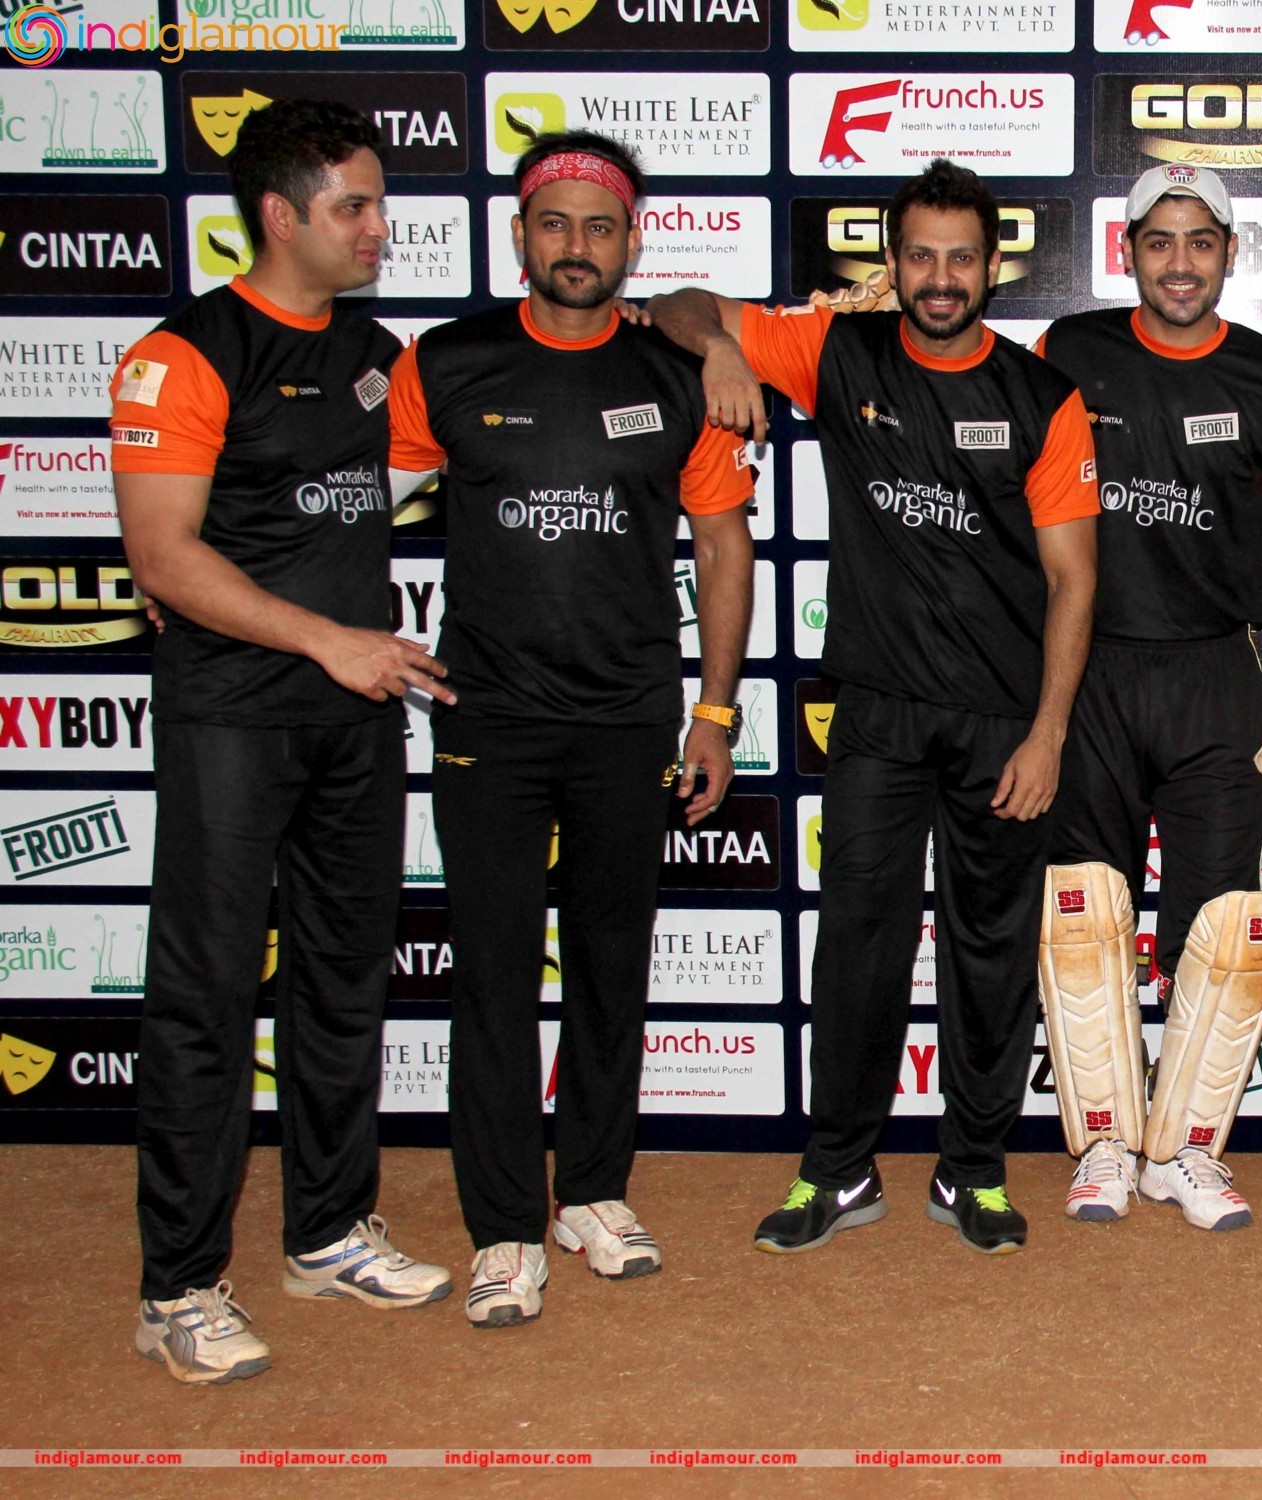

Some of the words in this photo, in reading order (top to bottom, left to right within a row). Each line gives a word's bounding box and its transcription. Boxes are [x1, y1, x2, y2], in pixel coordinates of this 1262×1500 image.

[617, 0, 760, 23] CINTAA
[885, 3, 1057, 17] ENTERTAINMENT
[887, 20, 947, 32] MEDIA
[963, 20, 999, 32] PVT.
[1018, 20, 1054, 32] LTD.
[1207, 25, 1223, 34] Visit
[1225, 26, 1234, 34] us
[1236, 26, 1252, 34] now
[1253, 25, 1261, 34] at
[901, 80, 1044, 108] frunch.us
[580, 96, 677, 122] WHITE
[690, 96, 754, 122] LEAF
[901, 122, 932, 131] Health
[935, 122, 956, 131] with
[968, 122, 1005, 131] tasteful
[1008, 122, 1040, 131] Punch!
[713, 143, 750, 155] LTD.
[901, 149, 919, 158] Visit
[920, 150, 929, 158] us
[931, 150, 946, 158] now
[948, 149, 956, 158] at
[957, 149, 1012, 158] www.frunch.us
[20, 231, 162, 269] CINTAA
[666, 244, 703, 253] tasteful
[706, 244, 738, 253] Punch!
[646, 271, 654, 279] at
[656, 271, 709, 279] www.frunch.us
[505, 416, 534, 425] CINTAA
[609, 410, 658, 431] FROOTI
[1099, 415, 1123, 425] CINTAA
[960, 429, 1005, 444] FROOTI
[1190, 421, 1234, 440] FROOTI
[14, 444, 109, 472] frunch
[15, 484, 46, 493] Health
[48, 484, 69, 493] with
[80, 484, 114, 493] tastefu
[529, 485, 599, 505] Morarka
[897, 477, 954, 504] Morarka
[1131, 477, 1188, 499] Morarka
[17, 510, 34, 519] Visit
[36, 511, 44, 519] us
[46, 511, 60, 519] now
[61, 510, 69, 519] at
[867, 481, 982, 535] Organic
[1100, 481, 1215, 531] Organic
[498, 497, 629, 541] Organic
[0, 566, 142, 610] OLD
[0, 696, 151, 748] XYBOY
[2, 808, 128, 872] FROOTI
[664, 831, 771, 864] INTAA
[1058, 890, 1085, 907] SS
[706, 931, 765, 955] LEAF
[727, 974, 763, 986] LTD.
[645, 1028, 756, 1054] unch.us
[684, 1066, 719, 1075] tasteful
[722, 1066, 753, 1075] Punch!
[665, 1089, 673, 1097] at
[674, 1089, 726, 1097] www.frunch.us
[1086, 1110, 1112, 1126] SS
[1189, 1126, 1216, 1142] SS
